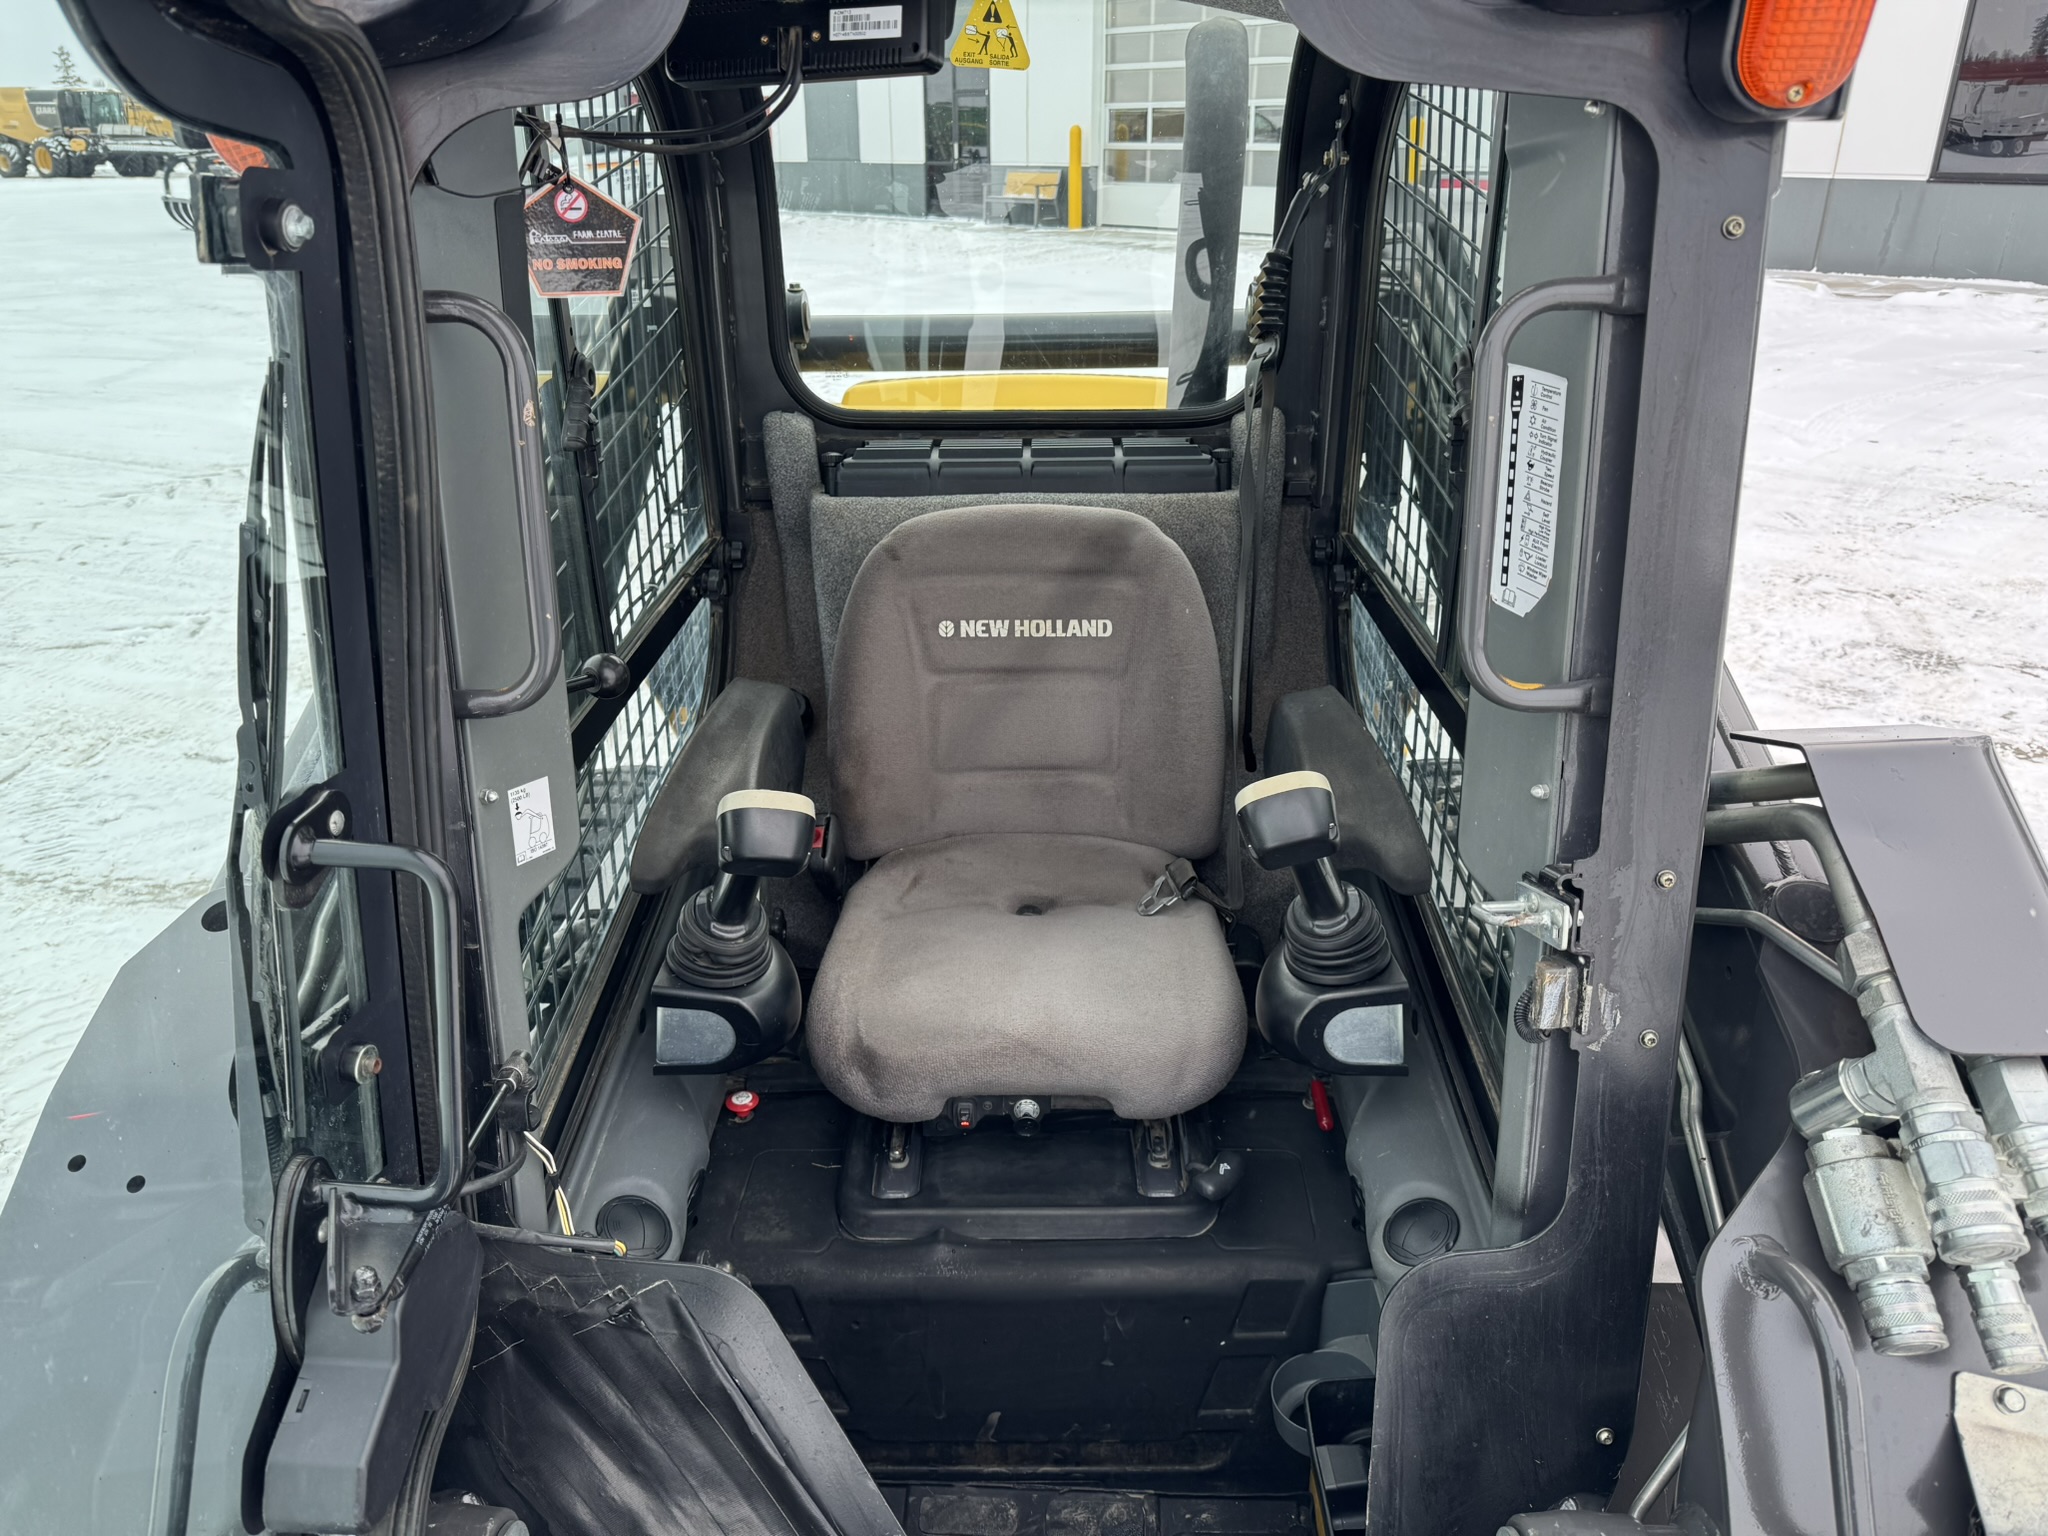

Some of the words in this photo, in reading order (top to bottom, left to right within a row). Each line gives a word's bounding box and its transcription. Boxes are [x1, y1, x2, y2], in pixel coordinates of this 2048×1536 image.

[532, 258, 553, 270] NO
[556, 257, 622, 270] SMOKING
[1540, 424, 1556, 433] Condition
[960, 619, 1010, 638] NEW
[1014, 619, 1113, 638] HOLLAND
